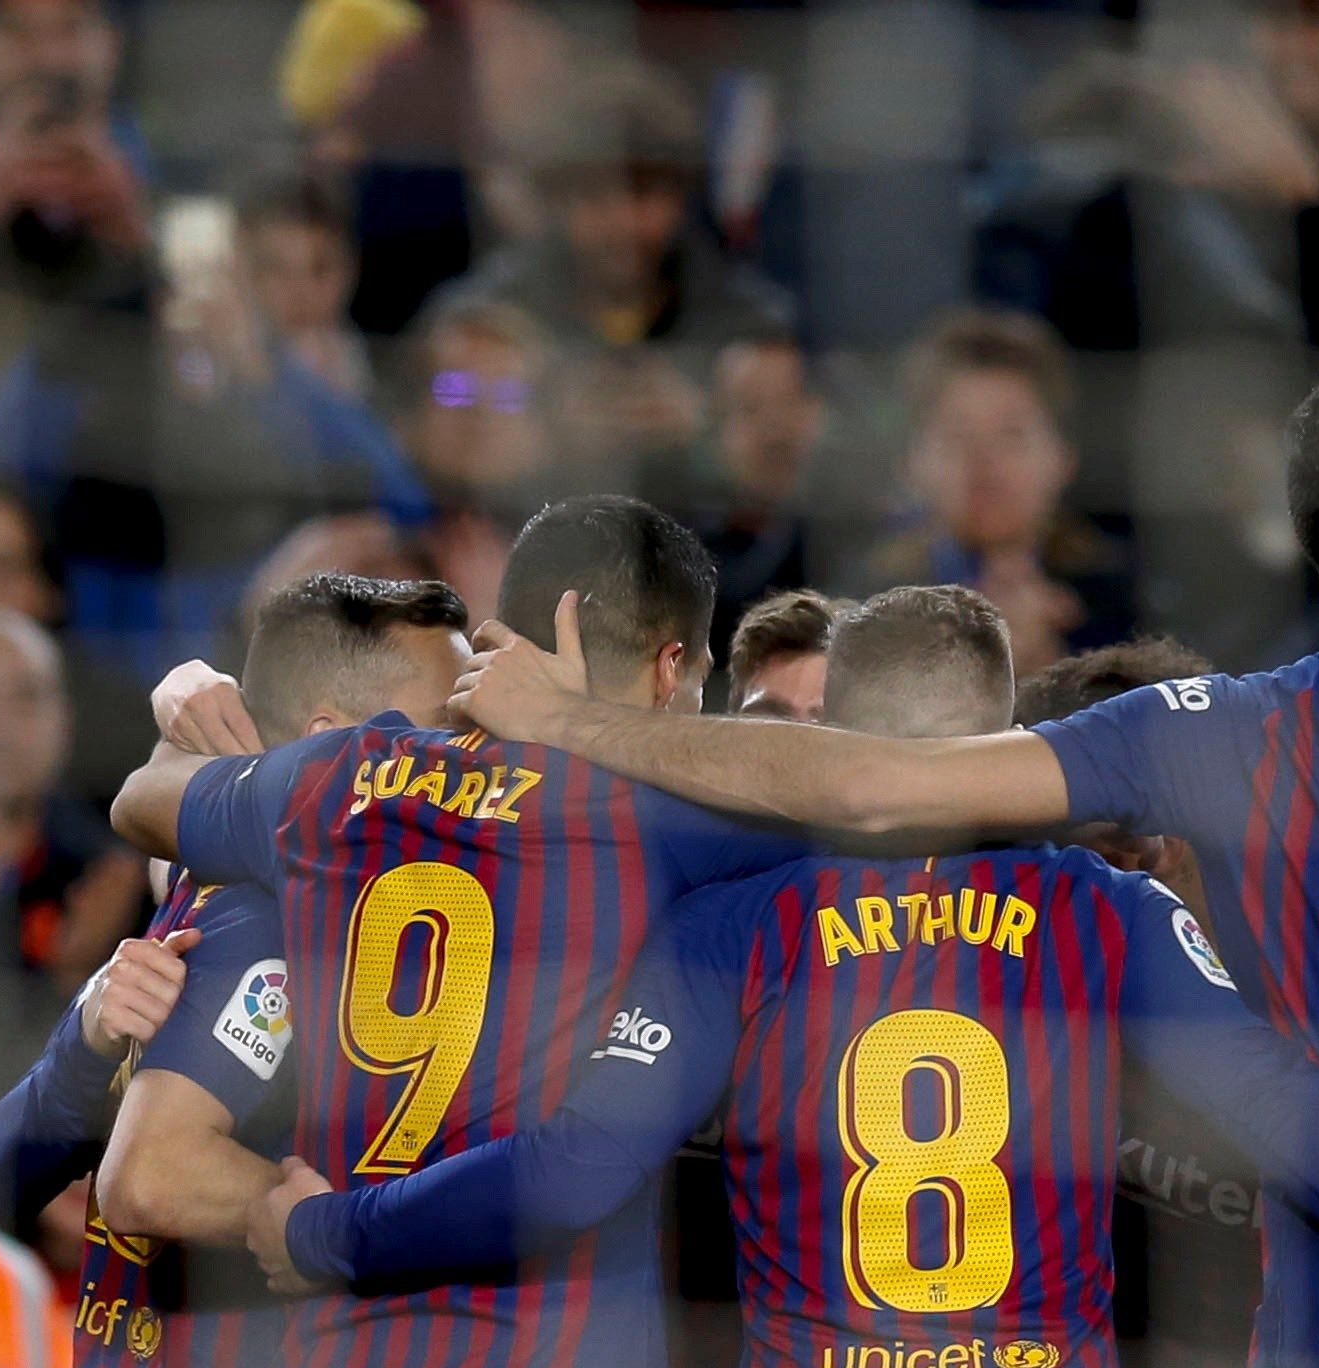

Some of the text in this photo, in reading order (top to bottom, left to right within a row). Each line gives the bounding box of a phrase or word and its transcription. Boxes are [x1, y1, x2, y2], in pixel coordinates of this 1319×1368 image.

[1171, 676, 1211, 712] ko
[350, 756, 543, 824] SUÁREZ
[817, 888, 1037, 967] ARTHUR
[223, 1018, 277, 1065] LaLiga
[338, 861, 495, 1175] 9
[606, 1007, 672, 1054] eko
[838, 1009, 1015, 1312] 8
